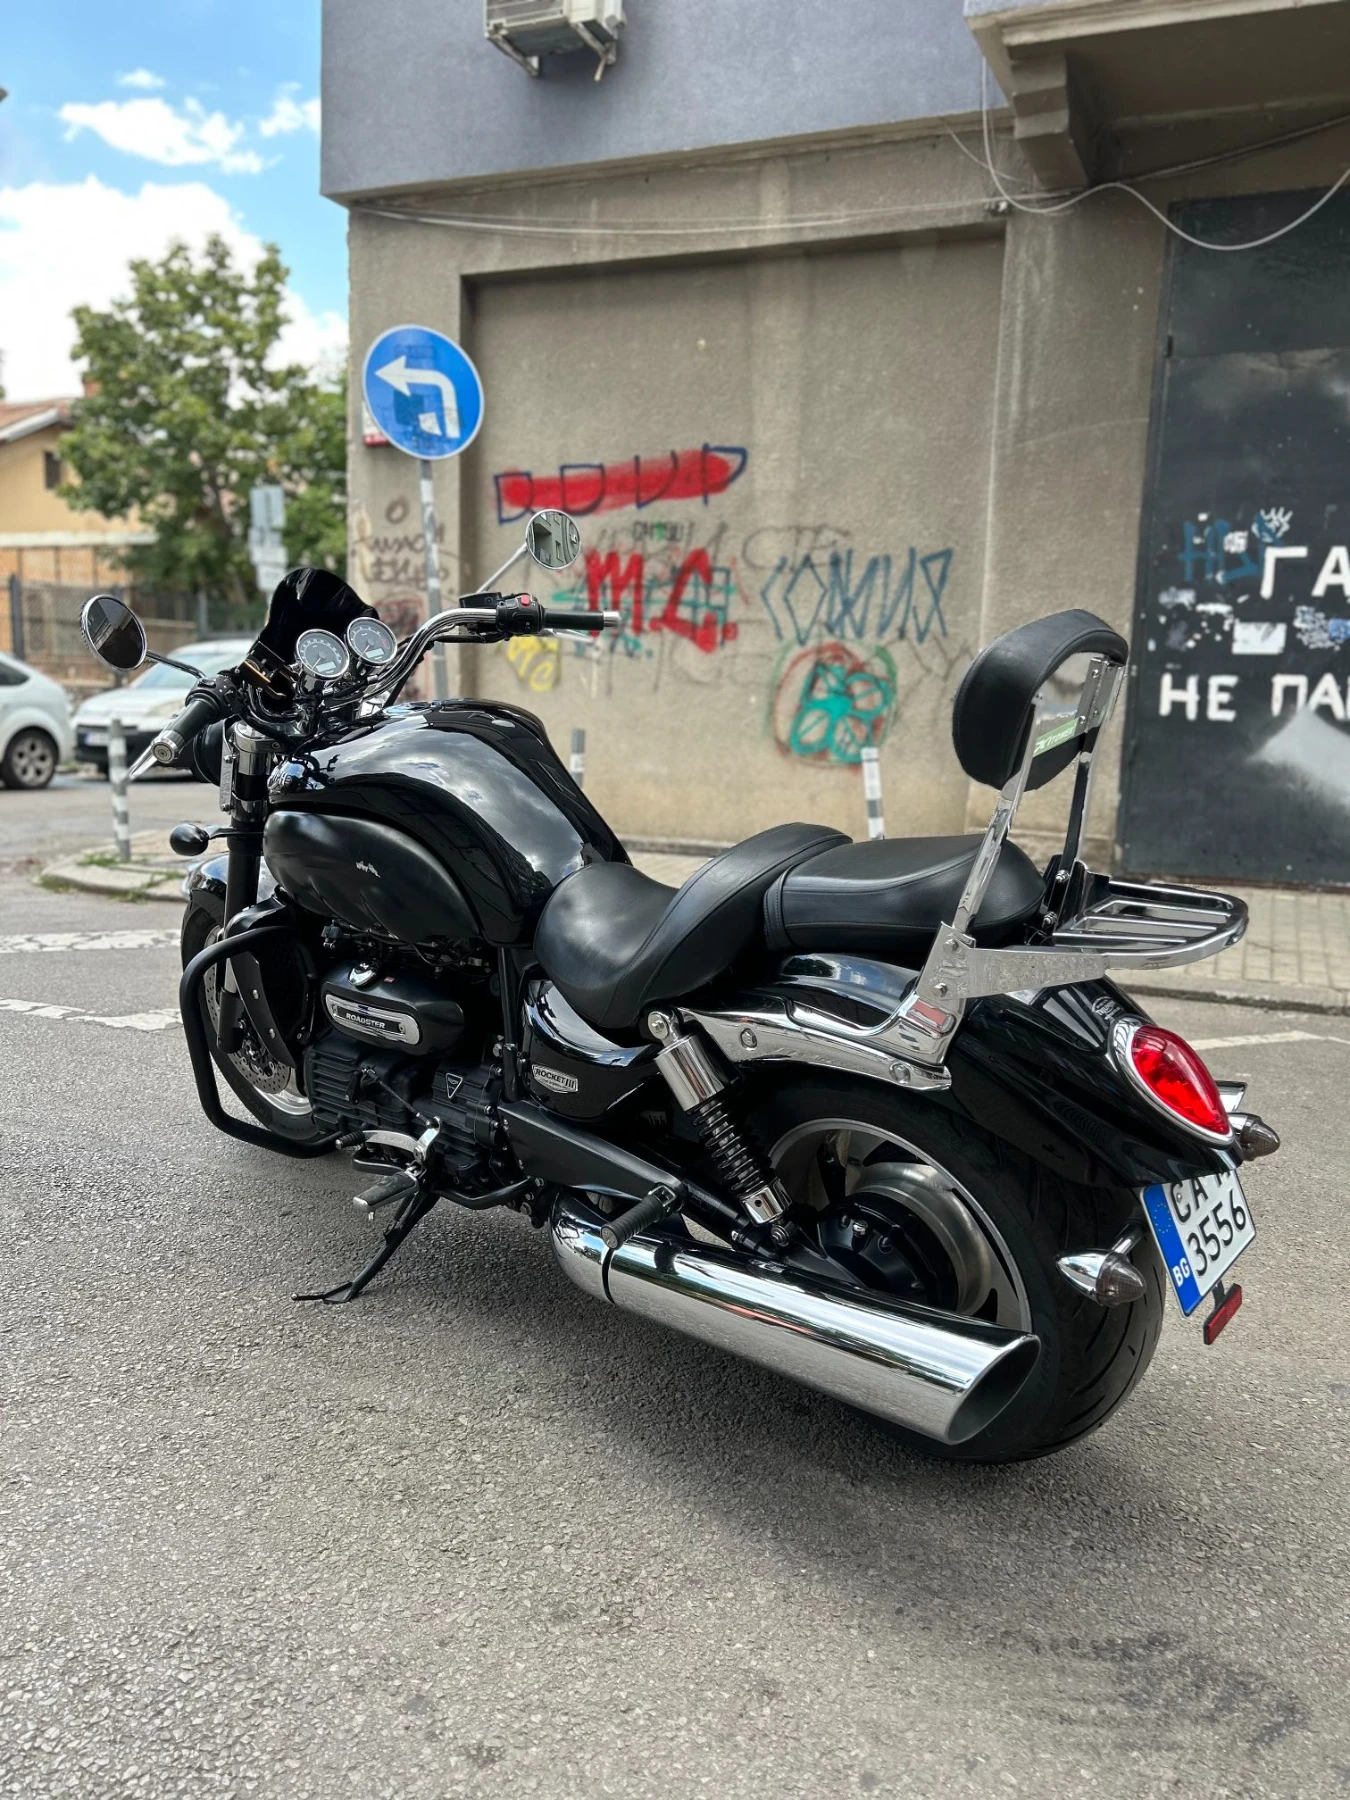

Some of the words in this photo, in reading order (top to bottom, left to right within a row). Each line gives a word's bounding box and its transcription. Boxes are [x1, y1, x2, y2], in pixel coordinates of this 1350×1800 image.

[1158, 672, 1240, 721] НЕ
[1271, 672, 1350, 721] ПА
[345, 1012, 386, 1030] ROADSTER
[535, 1068, 566, 1084] ROCKET
[1187, 1188, 1246, 1277] 3556
[1172, 1257, 1191, 1288] BG
